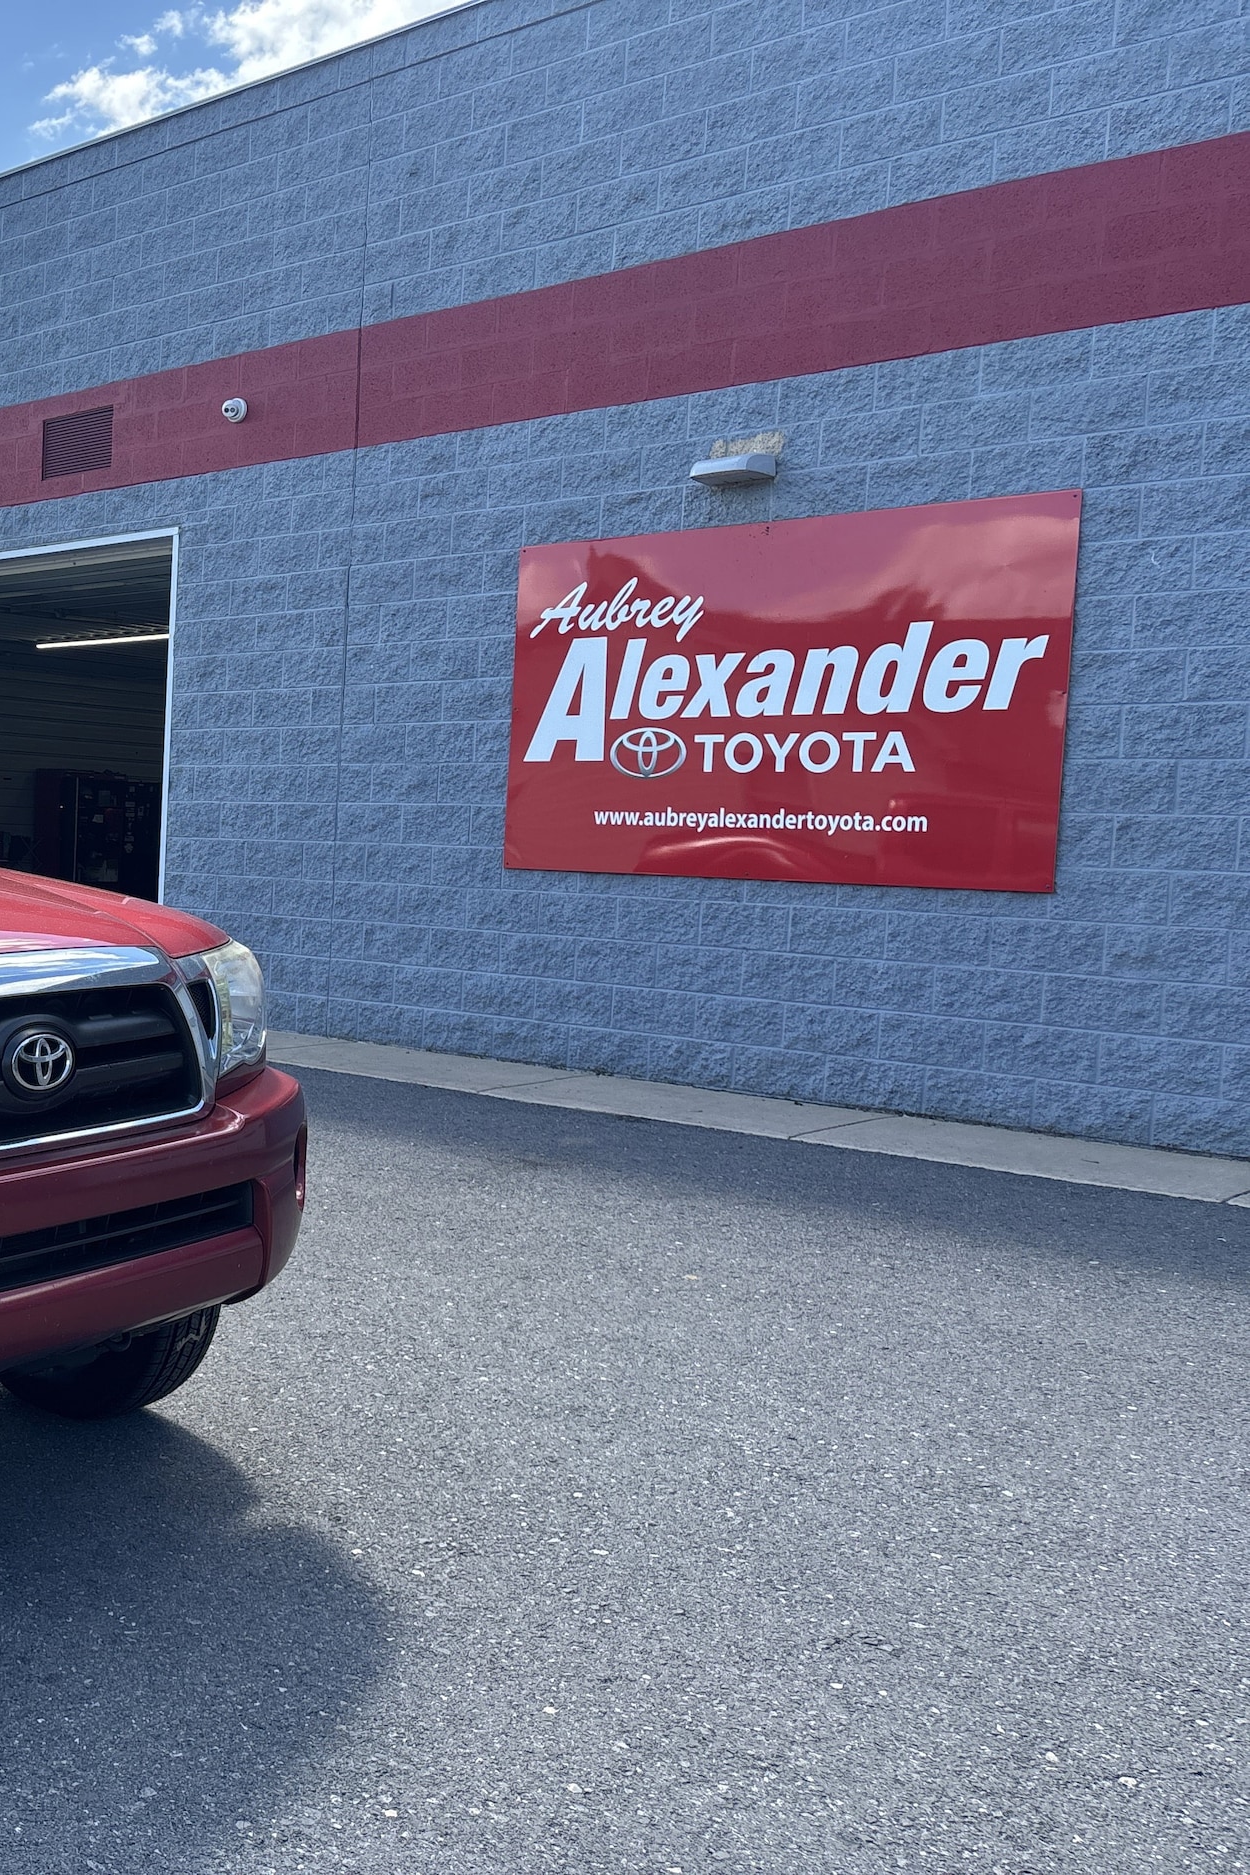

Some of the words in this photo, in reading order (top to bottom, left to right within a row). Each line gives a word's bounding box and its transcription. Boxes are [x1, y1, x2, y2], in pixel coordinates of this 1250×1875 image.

[530, 576, 705, 643] Aubrey
[522, 620, 1051, 763] Alexander
[693, 730, 917, 775] TOYOTA
[593, 806, 929, 836] www.aubreyalexandertoyota.com
